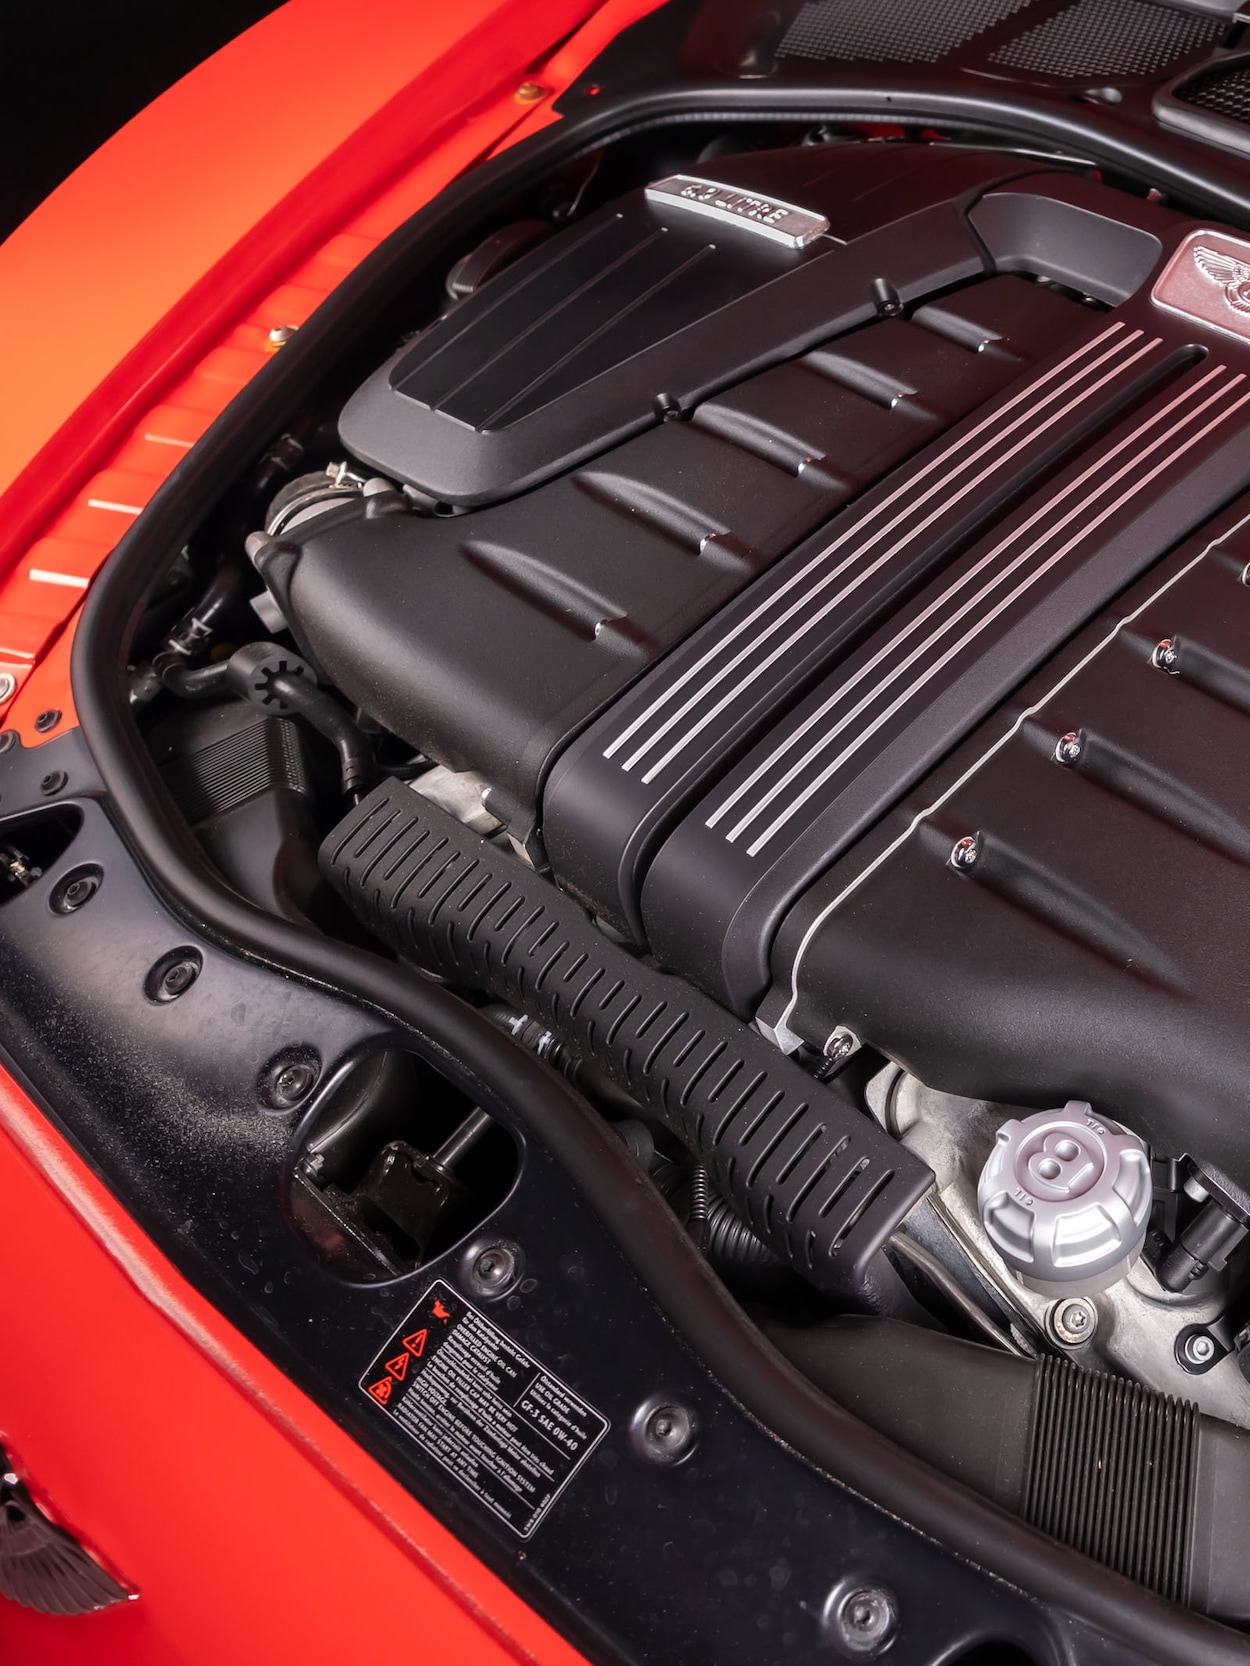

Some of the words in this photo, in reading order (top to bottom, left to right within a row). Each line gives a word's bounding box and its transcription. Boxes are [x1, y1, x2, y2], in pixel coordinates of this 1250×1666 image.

[715, 193, 789, 224] LITRE
[451, 1329, 471, 1347] DAMAGE
[469, 1344, 491, 1364] CATALYST
[456, 1323, 482, 1347] OVERFILLED
[480, 1344, 499, 1362] ENGINE
[497, 1359, 506, 1369] OIL
[505, 1366, 517, 1378] CAN
[431, 1355, 449, 1372] ENGINE
[447, 1369, 456, 1379] OIL
[455, 1376, 471, 1391] FILLER
[469, 1388, 480, 1398] CAP
[478, 1397, 490, 1407] MAY
[488, 1405, 496, 1414] BE
[495, 1411, 508, 1423] VERY
[505, 1421, 518, 1432] HOT
[534, 1382, 546, 1393] USE
[544, 1390, 554, 1400] OIL
[552, 1397, 570, 1414] GRADE
[396, 1402, 419, 1424] RADIATOR
[418, 1421, 428, 1432] FAN
[426, 1430, 438, 1441] MAY
[436, 1438, 452, 1453] START
[456, 1457, 468, 1467] ANY
[466, 1465, 479, 1478] TIME
[412, 1380, 431, 1399] SWITCH
[429, 1396, 439, 1406] OFF
[437, 1404, 456, 1422] ENGINE
[454, 1419, 472, 1437] BEFORE
[471, 1434, 496, 1458] TOUCHING
[494, 1455, 518, 1477] IGNITION
[516, 1474, 535, 1492] SYSTEM
[521, 1400, 540, 1418] GF-3
[537, 1414, 555, 1431] SAE
[552, 1427, 578, 1450] 0W-40
